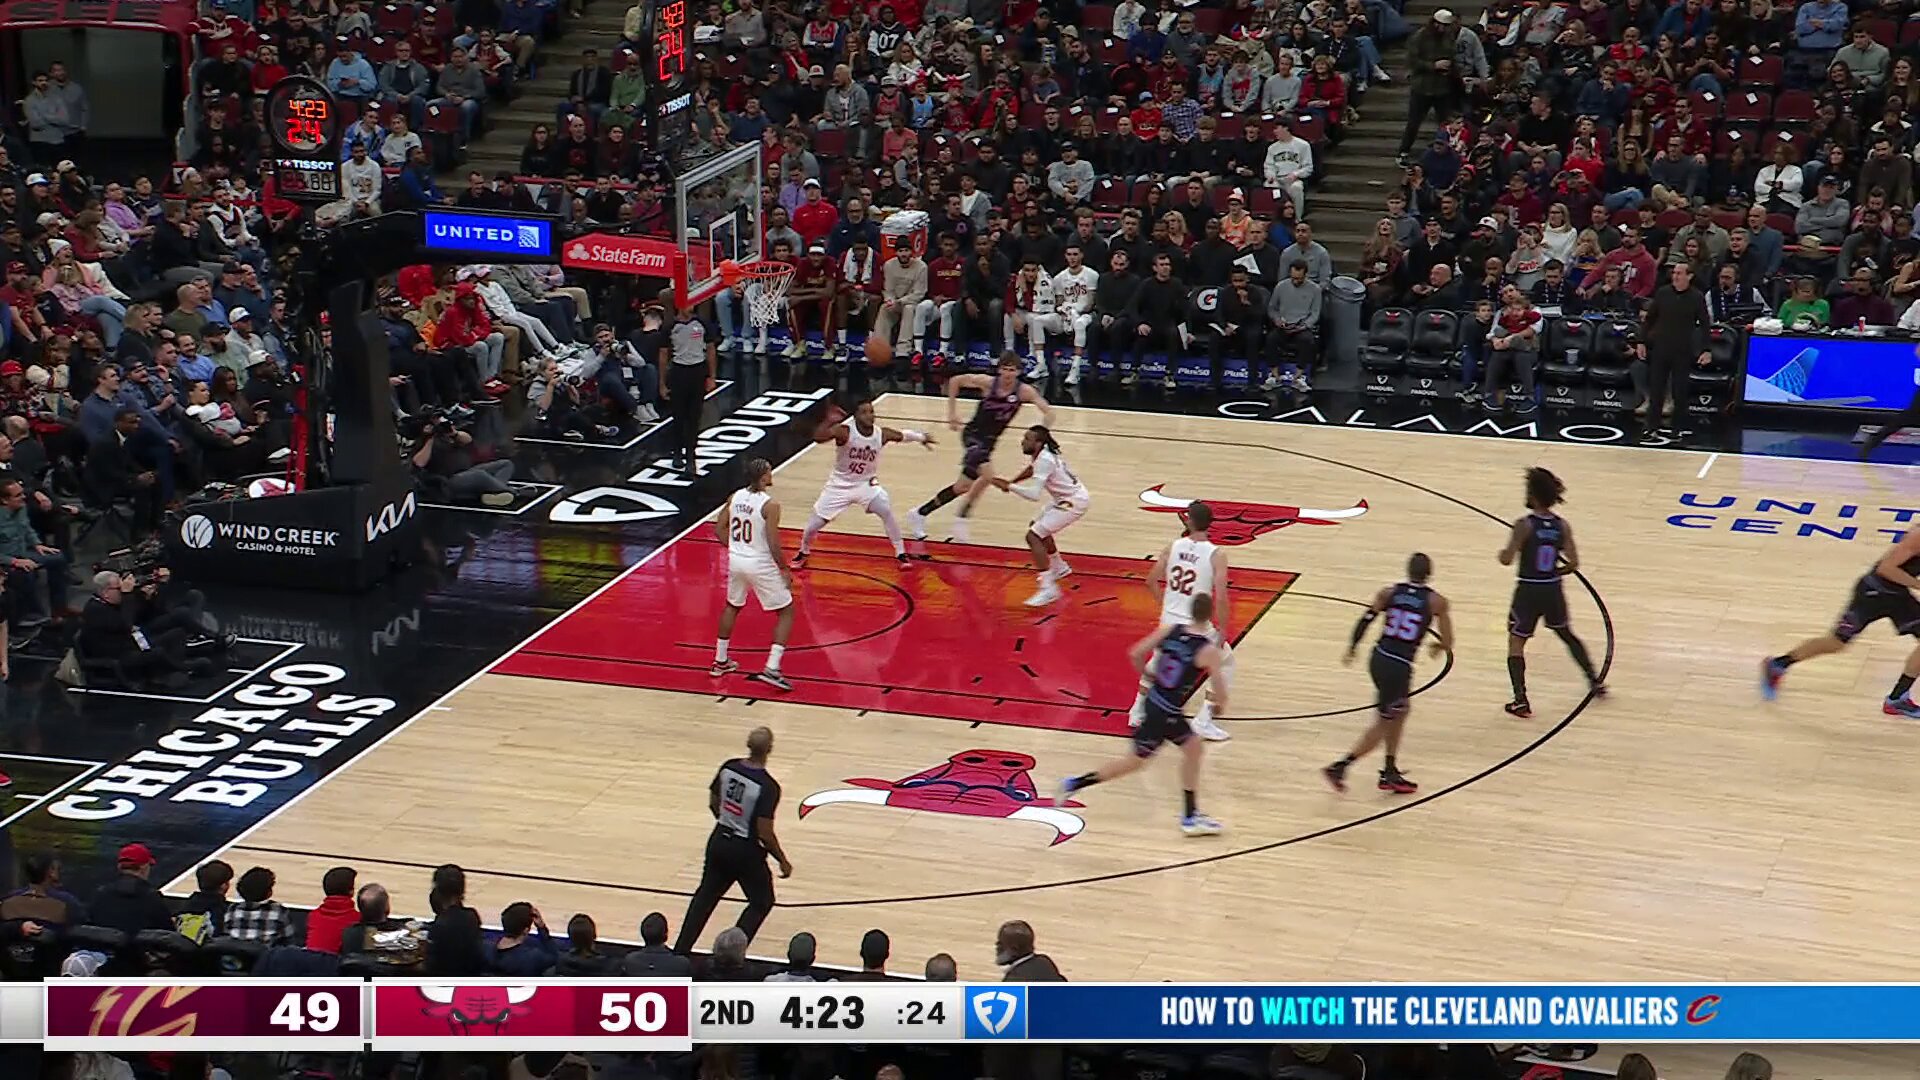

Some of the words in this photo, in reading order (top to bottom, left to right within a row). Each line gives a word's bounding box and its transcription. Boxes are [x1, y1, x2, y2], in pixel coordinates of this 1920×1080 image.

[879, 33, 899, 50] 07
[659, 29, 684, 80] 24
[667, 92, 691, 114] TISSOT
[286, 118, 323, 145] 24
[292, 160, 335, 170] TISSOT
[434, 224, 514, 242] UNITED
[1593, 400, 1623, 408] FANDUEL
[849, 446, 877, 463] CAVS
[848, 462, 866, 475] 45
[218, 522, 271, 541] WIND
[274, 527, 338, 546] CREEK
[731, 516, 753, 545] 20
[236, 541, 274, 553] CASINO
[275, 544, 283, 553] &
[284, 545, 316, 556] HOTEL
[1169, 565, 1197, 596] 32
[1385, 607, 1423, 641] 35
[47, 663, 347, 821] CHICAGO
[168, 693, 397, 808] BULLS
[726, 777, 746, 804] 30
